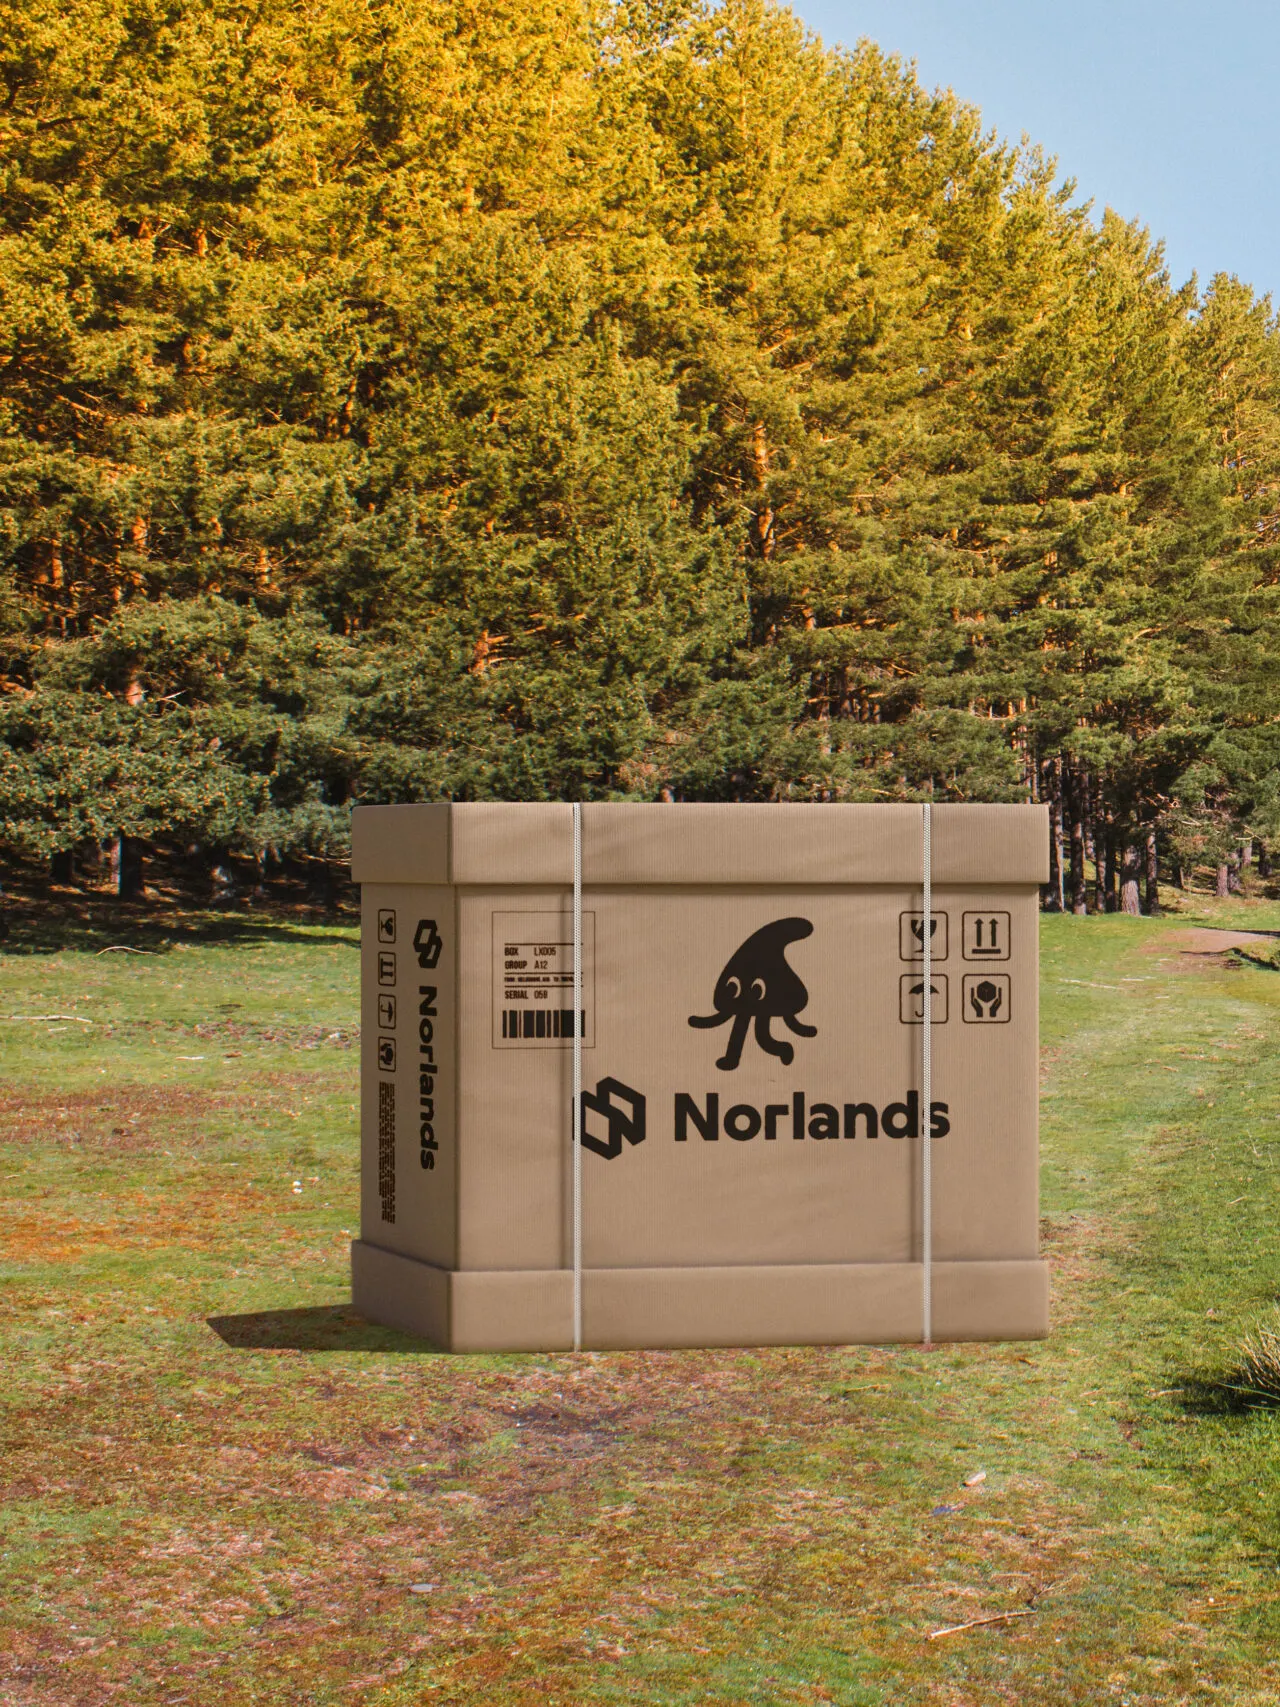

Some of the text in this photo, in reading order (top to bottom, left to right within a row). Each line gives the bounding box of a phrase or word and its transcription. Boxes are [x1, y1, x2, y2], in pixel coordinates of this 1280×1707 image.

[534, 960, 548, 969] A12
[504, 990, 528, 999] SERIAL
[419, 985, 439, 1171] Norlands
[674, 1089, 951, 1142] Norlands
